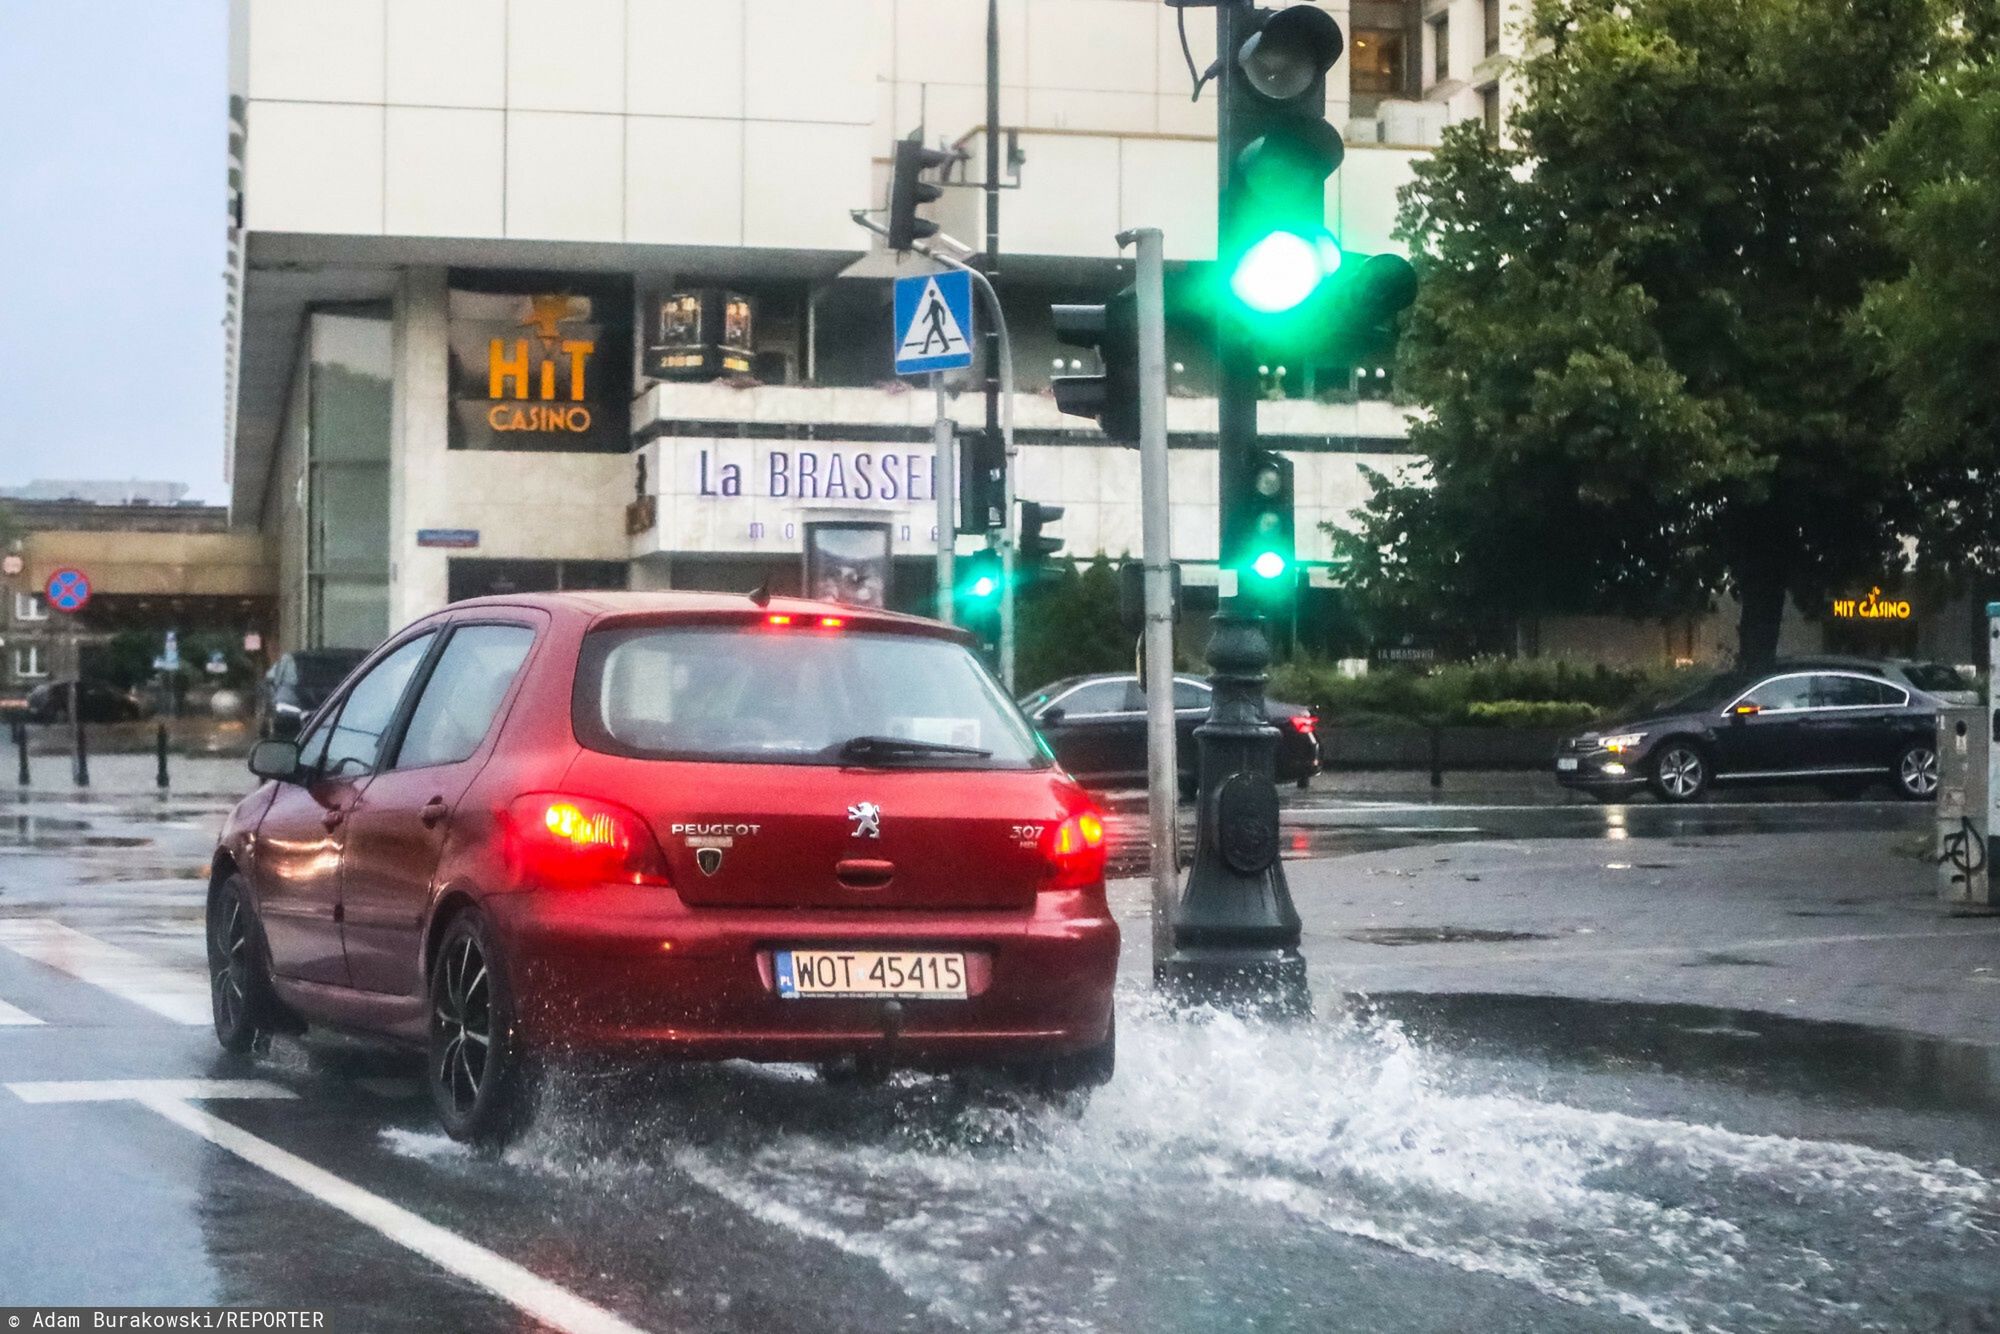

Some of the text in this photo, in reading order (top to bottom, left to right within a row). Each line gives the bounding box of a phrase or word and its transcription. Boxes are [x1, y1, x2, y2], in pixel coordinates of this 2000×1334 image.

[488, 403, 591, 432] CASINO
[700, 450, 938, 500] La BRASSE
[1834, 600, 1911, 618] HIT CASINO
[671, 823, 761, 836] PEUGEOT
[1009, 825, 1045, 839] 307
[780, 976, 792, 986] PL
[796, 956, 961, 989] WOT 45415
